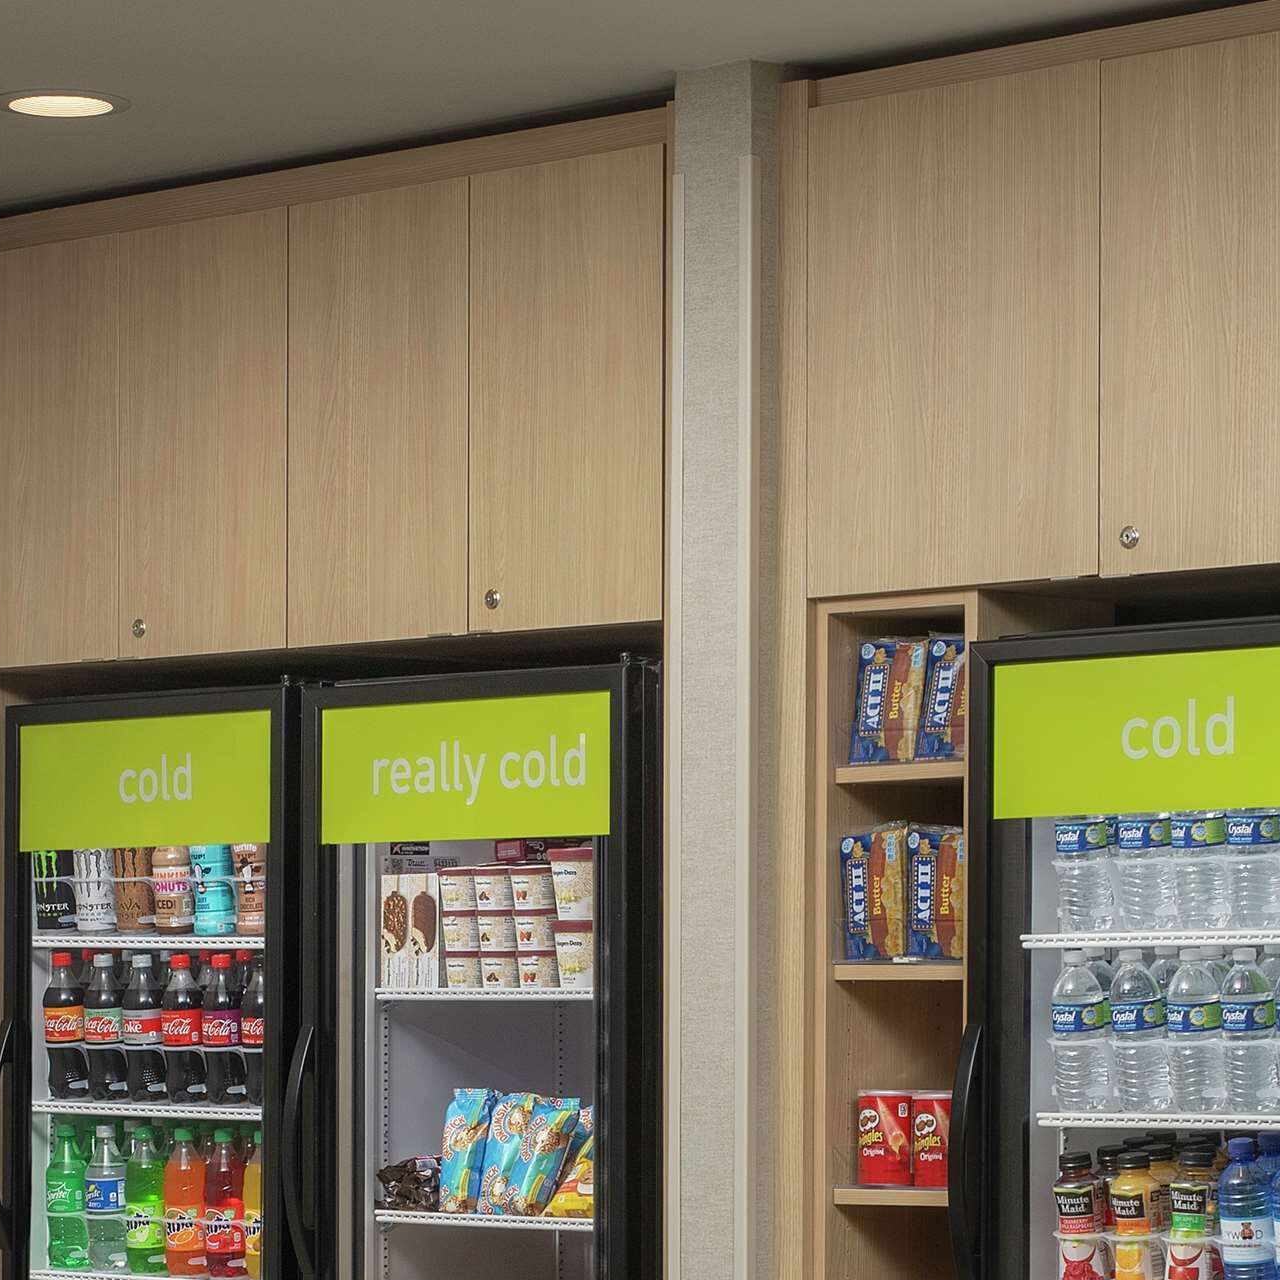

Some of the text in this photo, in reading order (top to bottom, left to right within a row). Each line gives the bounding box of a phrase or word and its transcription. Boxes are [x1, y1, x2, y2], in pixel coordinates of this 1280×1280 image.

[888, 680, 903, 720] Butter
[1121, 696, 1235, 760] cold
[118, 752, 193, 805] cold
[372, 733, 587, 806] really cold
[154, 881, 188, 892] ONUTS
[873, 875, 882, 916] Butter
[940, 875, 951, 915] Butter
[124, 1021, 143, 1033] oke
[1061, 1204, 1086, 1213] Maid
[1171, 1190, 1203, 1201] Minute
[1173, 1201, 1200, 1211] Maid
